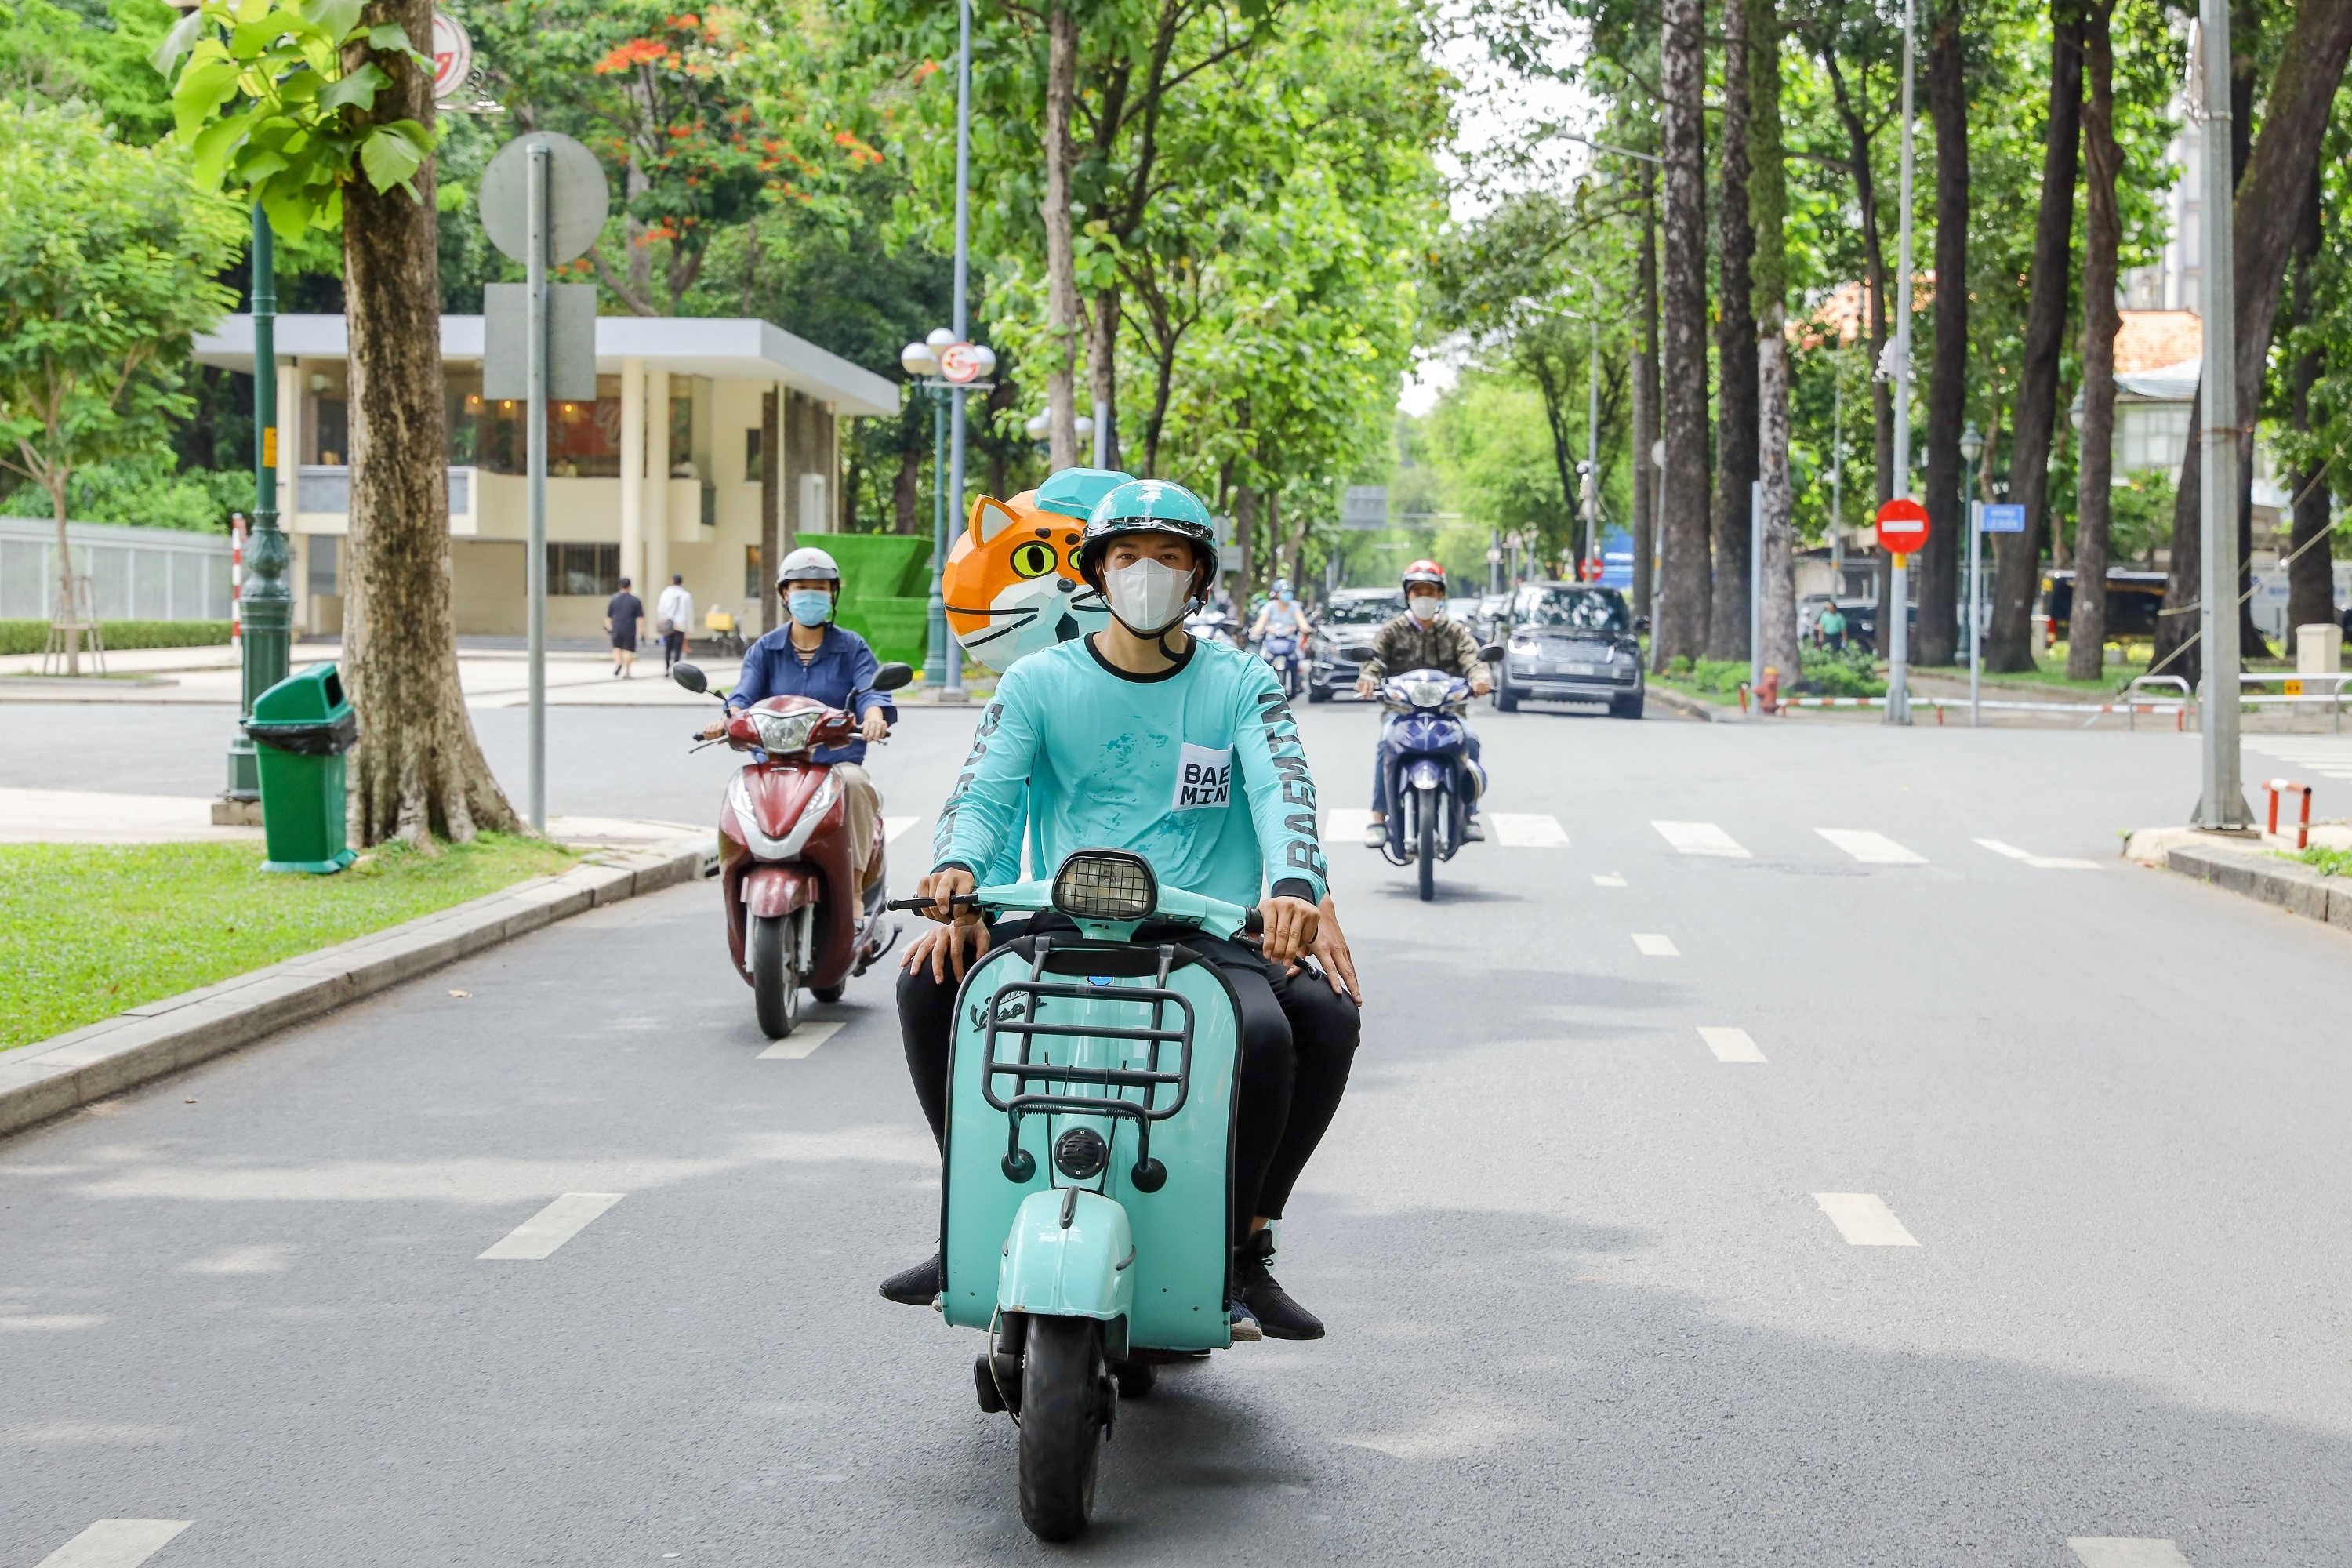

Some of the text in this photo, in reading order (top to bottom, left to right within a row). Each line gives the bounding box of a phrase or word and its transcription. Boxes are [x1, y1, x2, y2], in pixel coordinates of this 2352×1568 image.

[1184, 763, 1231, 786] BAE
[1180, 784, 1229, 805] MIN
[1258, 693, 1326, 880] BAEMIN
